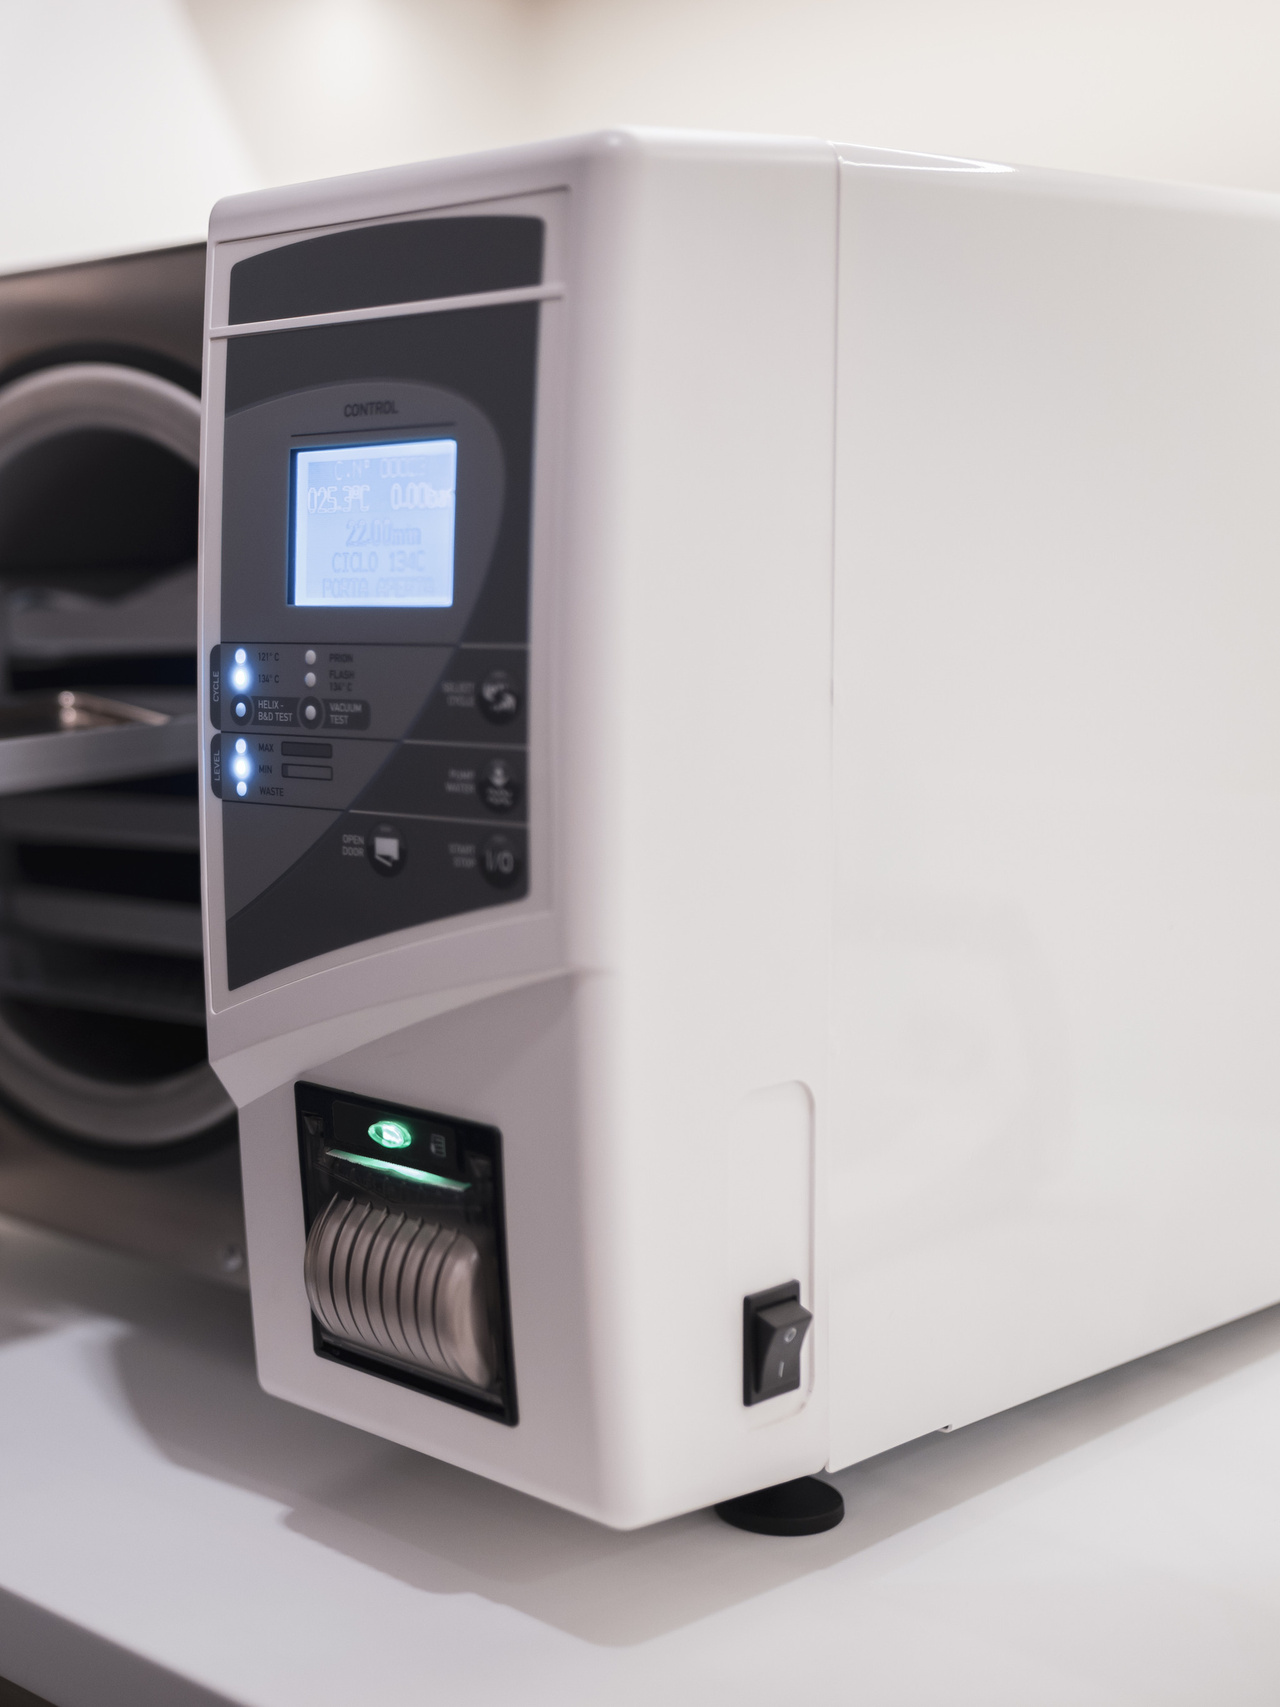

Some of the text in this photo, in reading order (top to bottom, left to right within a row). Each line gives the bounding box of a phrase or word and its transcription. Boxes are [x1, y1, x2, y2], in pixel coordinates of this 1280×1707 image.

[343, 401, 399, 418] CONTROL
[346, 519, 422, 548] 22.00mm
[332, 551, 379, 574] CICLO
[329, 653, 353, 663] PRION
[328, 670, 355, 680] FLASH
[212, 671, 220, 702] CYCLE
[258, 700, 279, 710] HELIX
[330, 702, 362, 713] VACUUM
[258, 711, 293, 723] B&D TEST
[330, 714, 349, 725] TEST
[258, 743, 274, 753] MAX
[258, 764, 273, 774] MIN
[259, 786, 284, 796] WASTE
[342, 834, 365, 845] OPEN
[342, 845, 365, 857] DOOR
